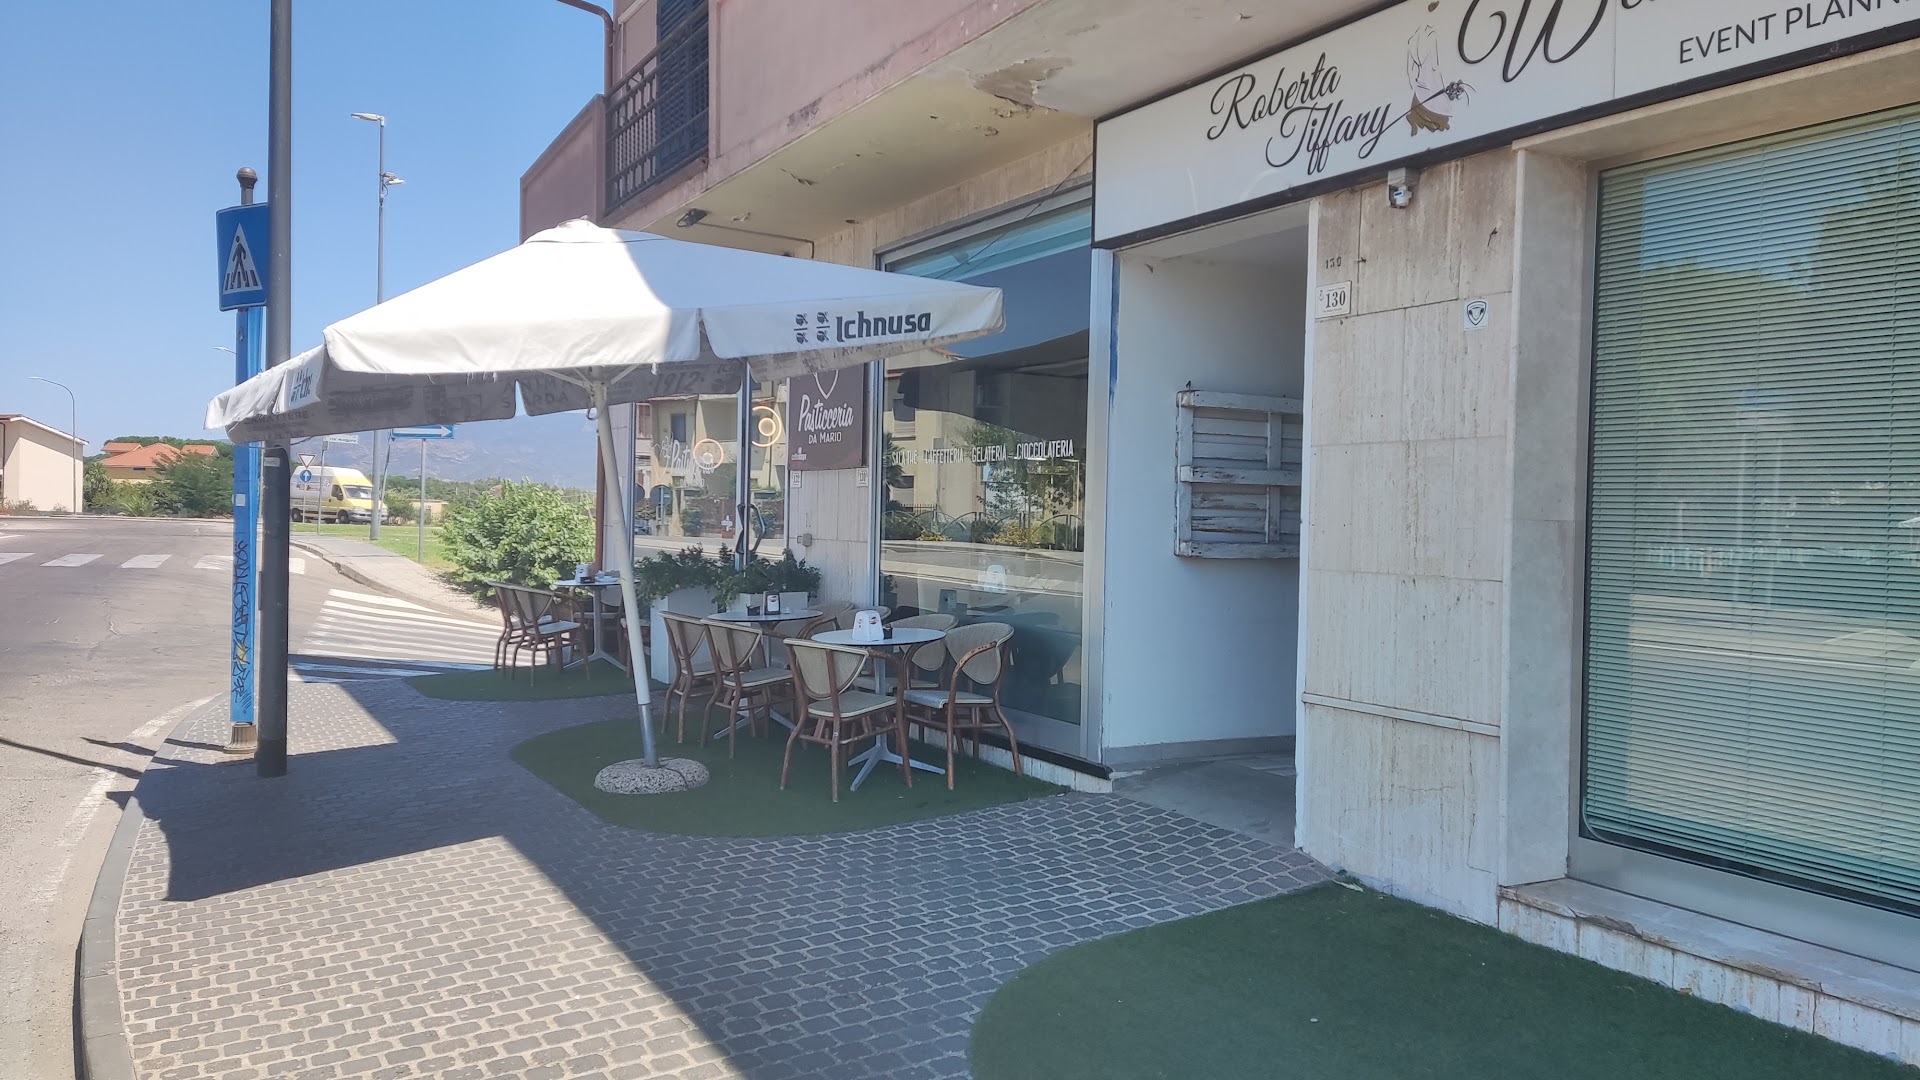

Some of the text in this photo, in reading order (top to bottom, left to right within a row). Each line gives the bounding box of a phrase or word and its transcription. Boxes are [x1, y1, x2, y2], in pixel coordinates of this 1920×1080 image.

[1679, 0, 1908, 64] EVENT PLAN
[1206, 51, 1342, 140] Roberta
[1265, 98, 1392, 175] Tiffany
[1325, 289, 1346, 309] 130
[836, 310, 932, 343] Ichnusa
[797, 394, 854, 432] Pasticceria
[808, 431, 842, 444] DA MARIO
[891, 451, 906, 466] SALA
[925, 447, 964, 465] CAFFETTERIA
[971, 443, 1007, 463] GELATERIA
[1017, 439, 1074, 460] CIOCCOLATERIA
